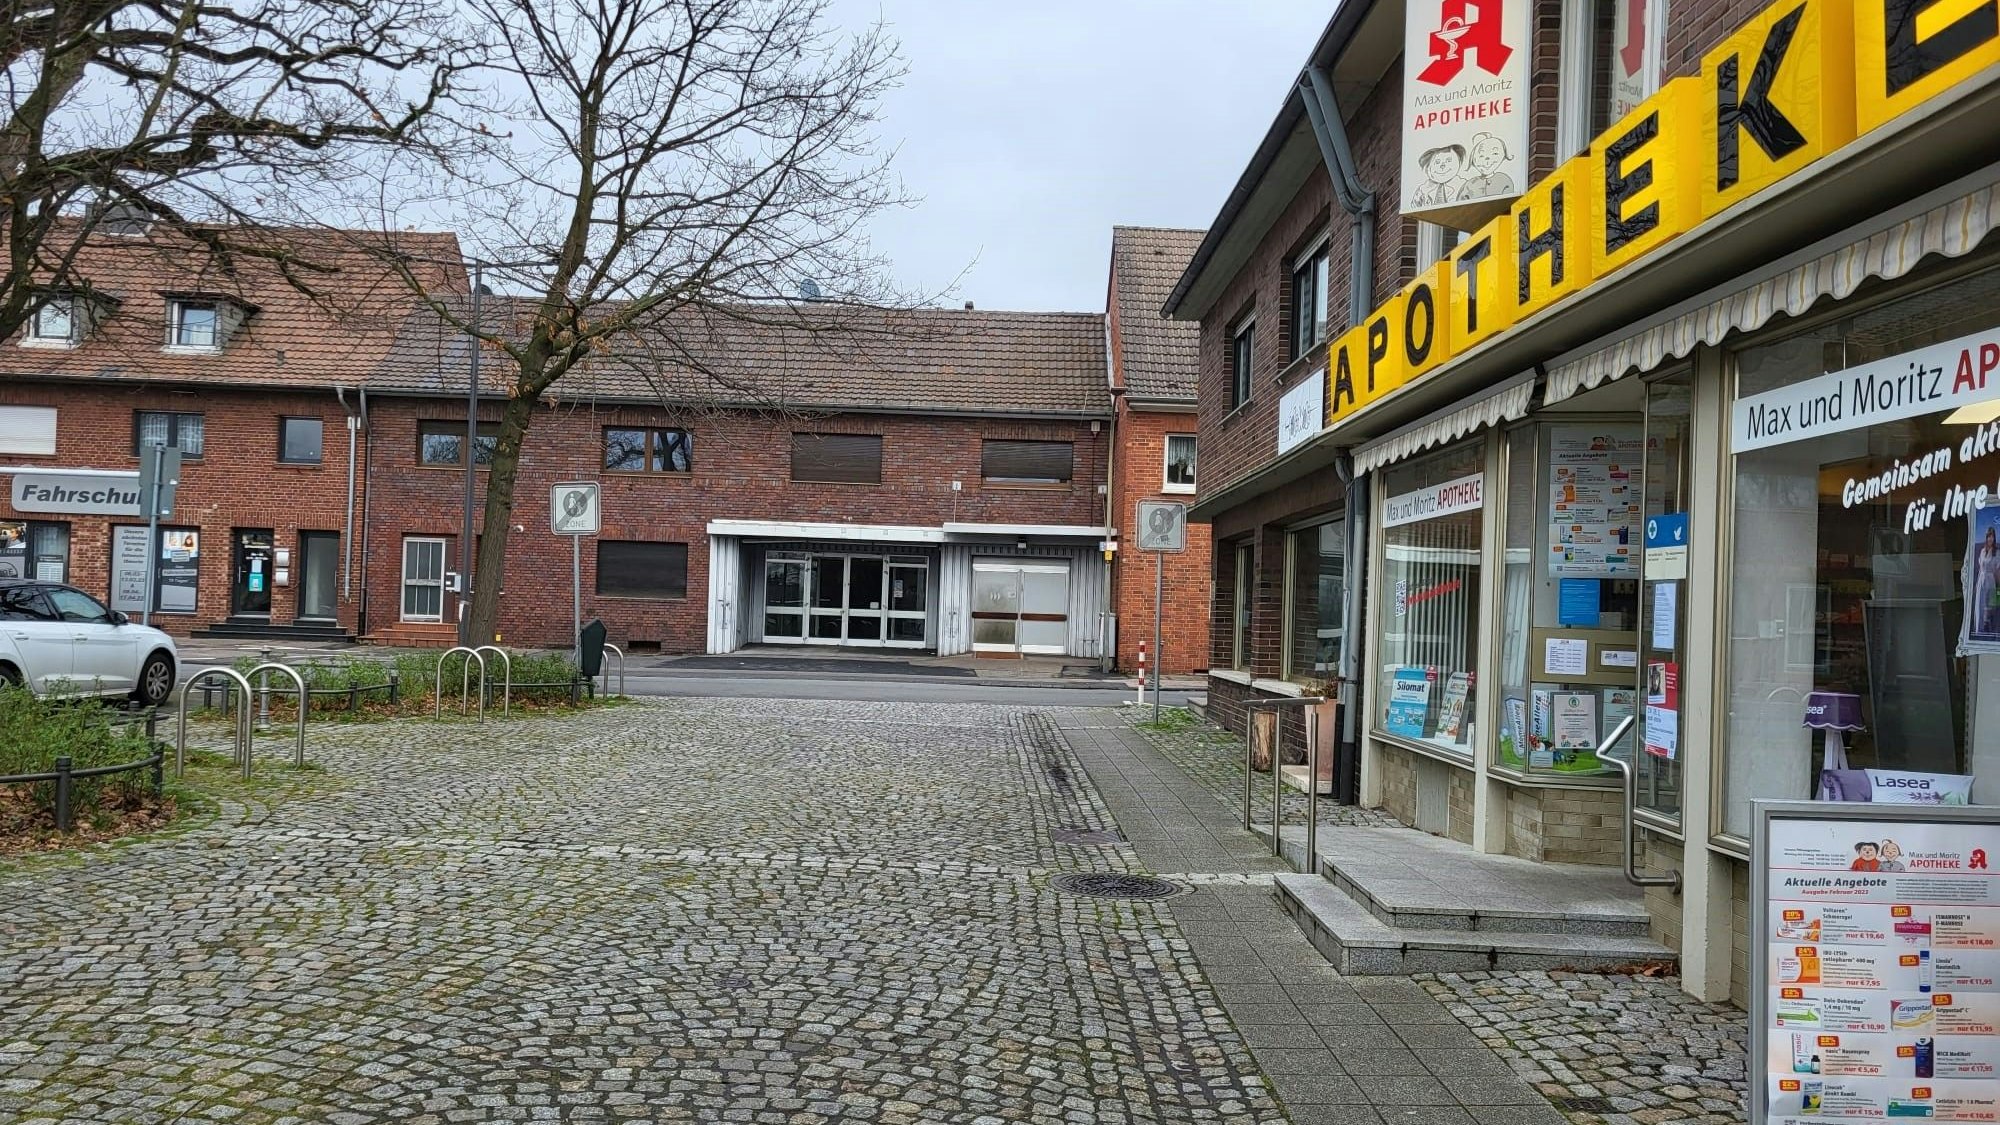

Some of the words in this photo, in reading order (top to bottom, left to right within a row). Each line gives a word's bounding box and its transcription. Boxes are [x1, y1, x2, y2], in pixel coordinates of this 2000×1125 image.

[1414, 94, 1441, 108] Max
[1444, 87, 1468, 102] und
[1470, 80, 1513, 97] Moritz
[1414, 98, 1512, 131] APOTHEKE
[1333, 0, 2000, 414] APOTHEKE
[1747, 402, 1792, 441] Max
[1799, 381, 1843, 430] und
[1852, 362, 1944, 416] Moritz
[1842, 447, 1952, 509] Gemeinsam
[1387, 503, 1399, 522] Max
[1400, 496, 1412, 517] und
[1413, 492, 1436, 515] Moritz
[1436, 479, 1481, 511] APOTHEKE
[1903, 498, 1936, 535] für
[1942, 483, 1989, 522] Ihre
[1396, 681, 1425, 692] Silomat
[1909, 859, 1961, 869] APOTHEKE
[1925, 851, 1938, 859] und
[1939, 851, 1961, 859] Moritz
[1783, 877, 1832, 887] Aktuelle
[1834, 877, 1888, 888] Angebote
[1898, 1004, 1932, 1013] Grippostad
